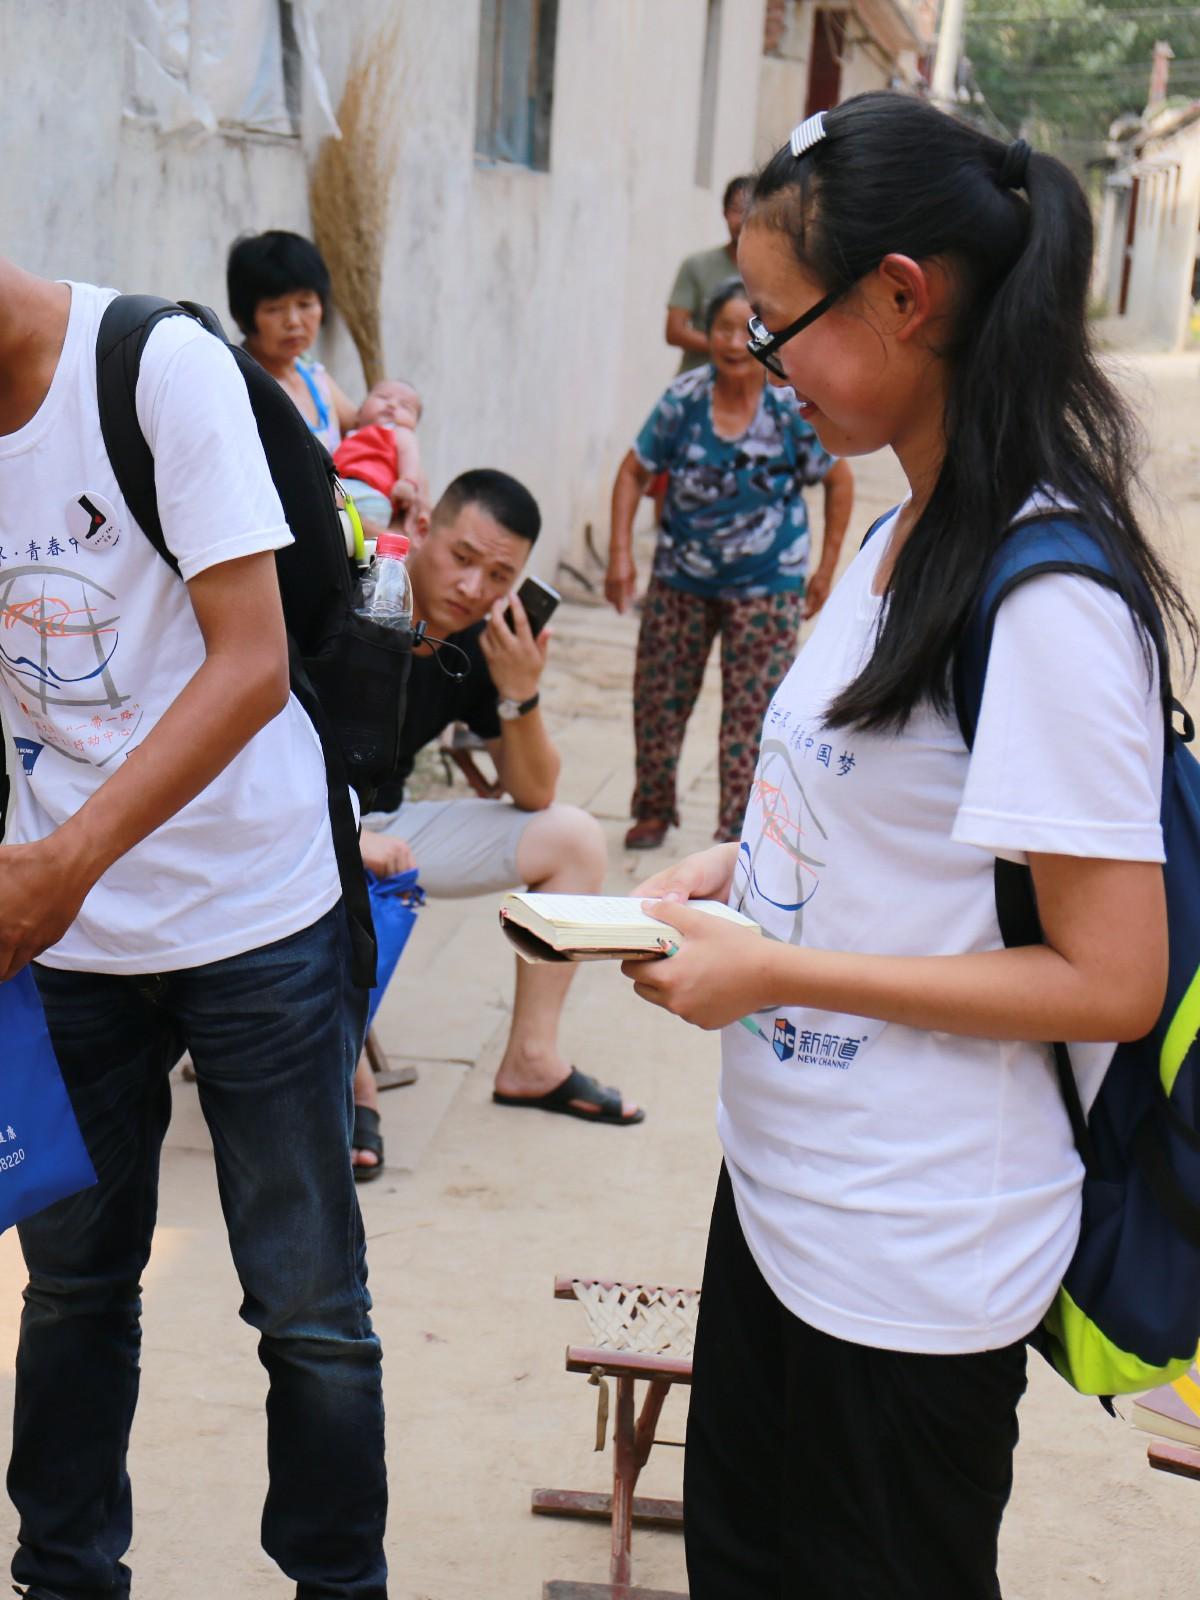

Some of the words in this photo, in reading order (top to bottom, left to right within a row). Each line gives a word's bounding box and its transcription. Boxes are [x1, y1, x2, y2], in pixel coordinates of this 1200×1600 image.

[798, 1030, 861, 1061] 新航道
[797, 1054, 817, 1064] NEW
